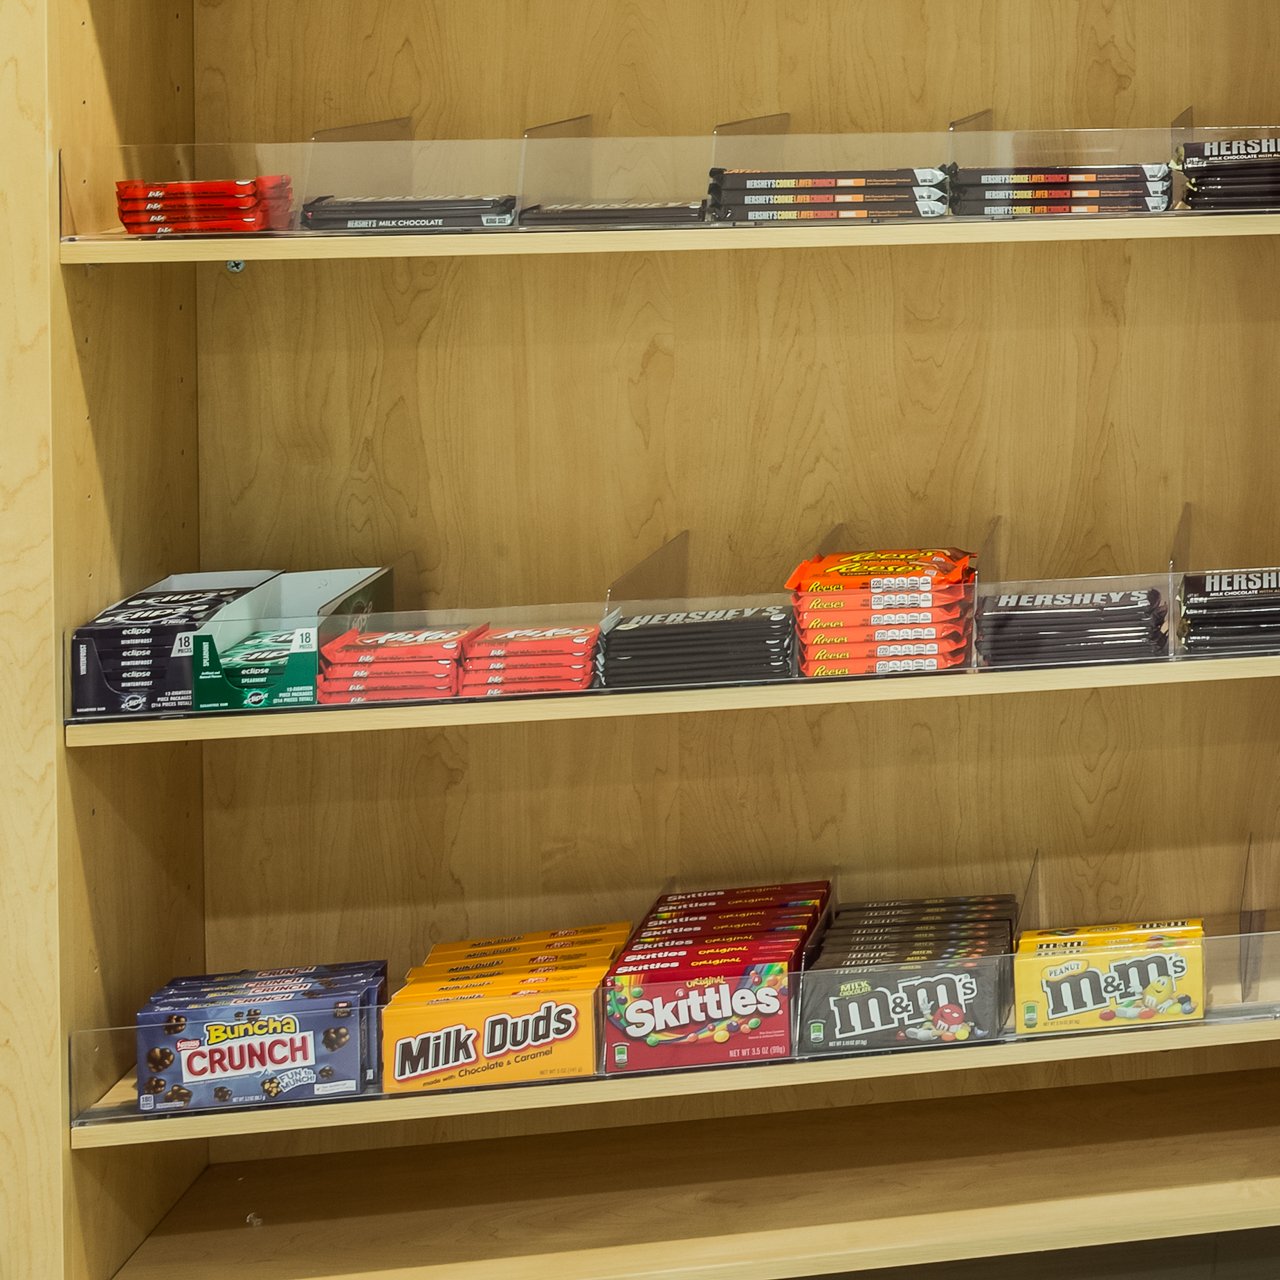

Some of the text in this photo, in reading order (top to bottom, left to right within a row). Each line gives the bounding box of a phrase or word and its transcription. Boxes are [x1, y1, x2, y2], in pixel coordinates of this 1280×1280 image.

[998, 591, 1148, 606] HERSHEY'S
[631, 606, 784, 626] HERSHEY'S
[178, 637, 190, 648] 18
[300, 633, 311, 643] 18
[241, 667, 269, 675] eclipse
[624, 950, 687, 961] Skittles
[615, 961, 679, 973] Skittles
[1048, 963, 1081, 977] PEANUT
[626, 984, 780, 1037] Skittles
[207, 1017, 296, 1044] Buncha
[398, 1006, 572, 1077] Milk Duds
[187, 1035, 309, 1076] CRUNCH
[458, 1048, 552, 1077] Chocolate Caramel
[279, 1072, 302, 1084] FUN
